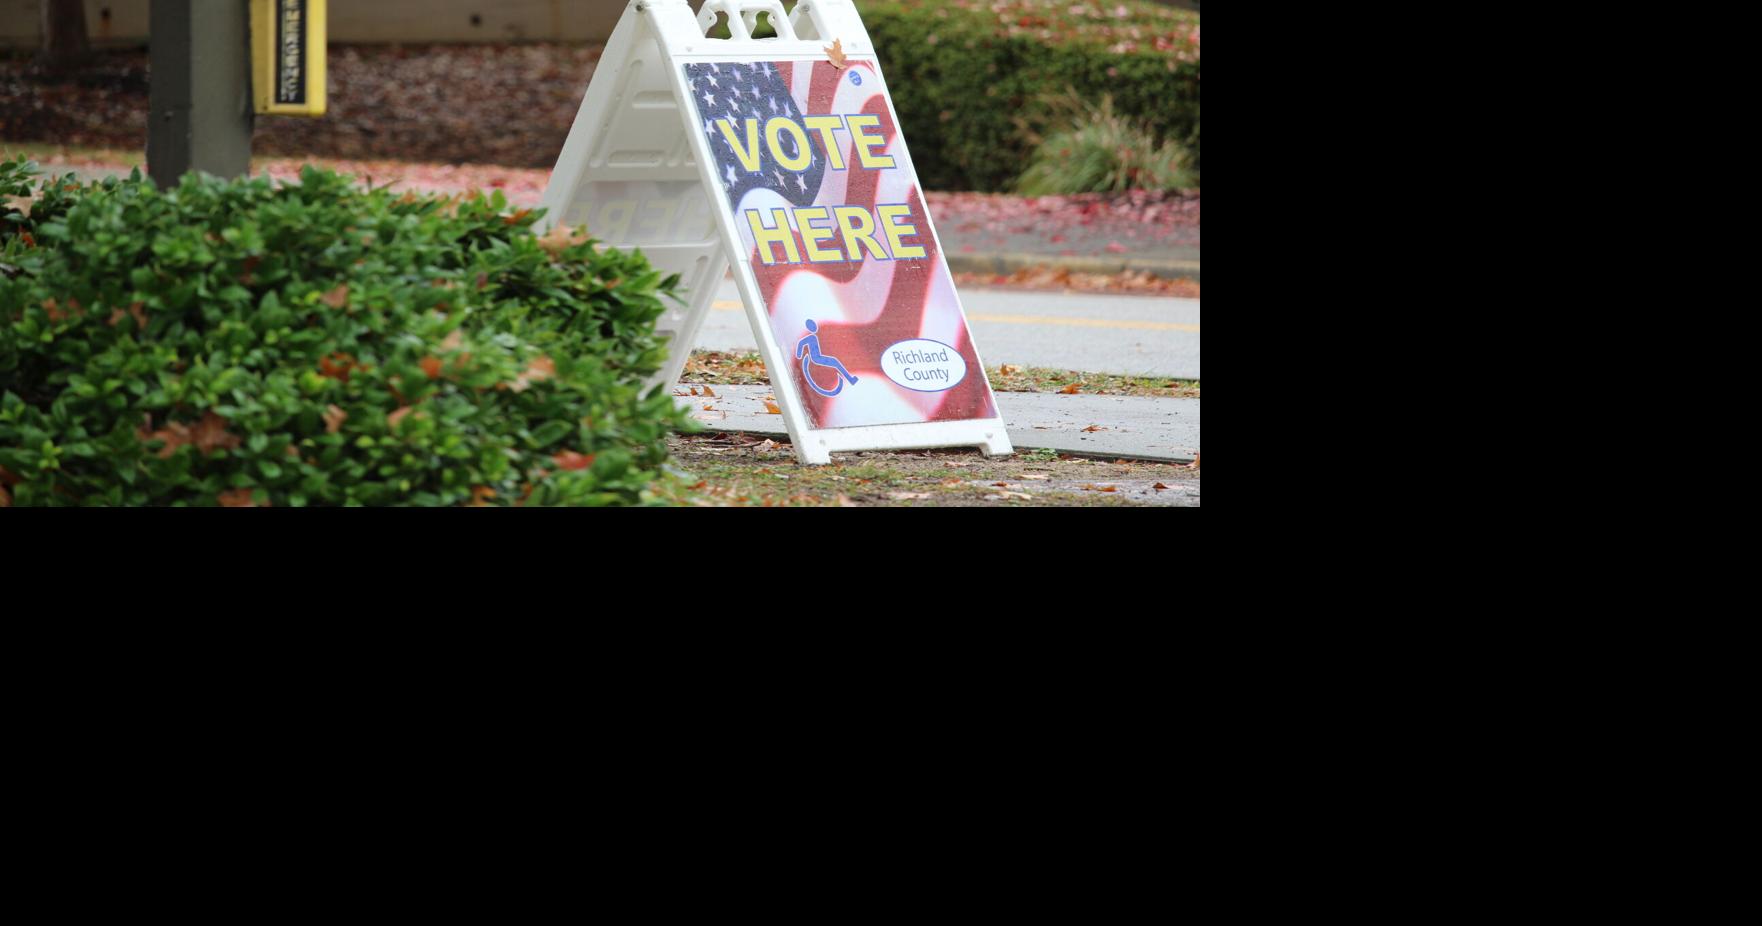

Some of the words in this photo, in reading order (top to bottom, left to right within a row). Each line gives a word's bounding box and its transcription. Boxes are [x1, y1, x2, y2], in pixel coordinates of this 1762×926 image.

[715, 114, 897, 172] VOTE
[744, 204, 928, 265] HERE
[892, 348, 949, 365] Richland
[903, 367, 949, 382] County
